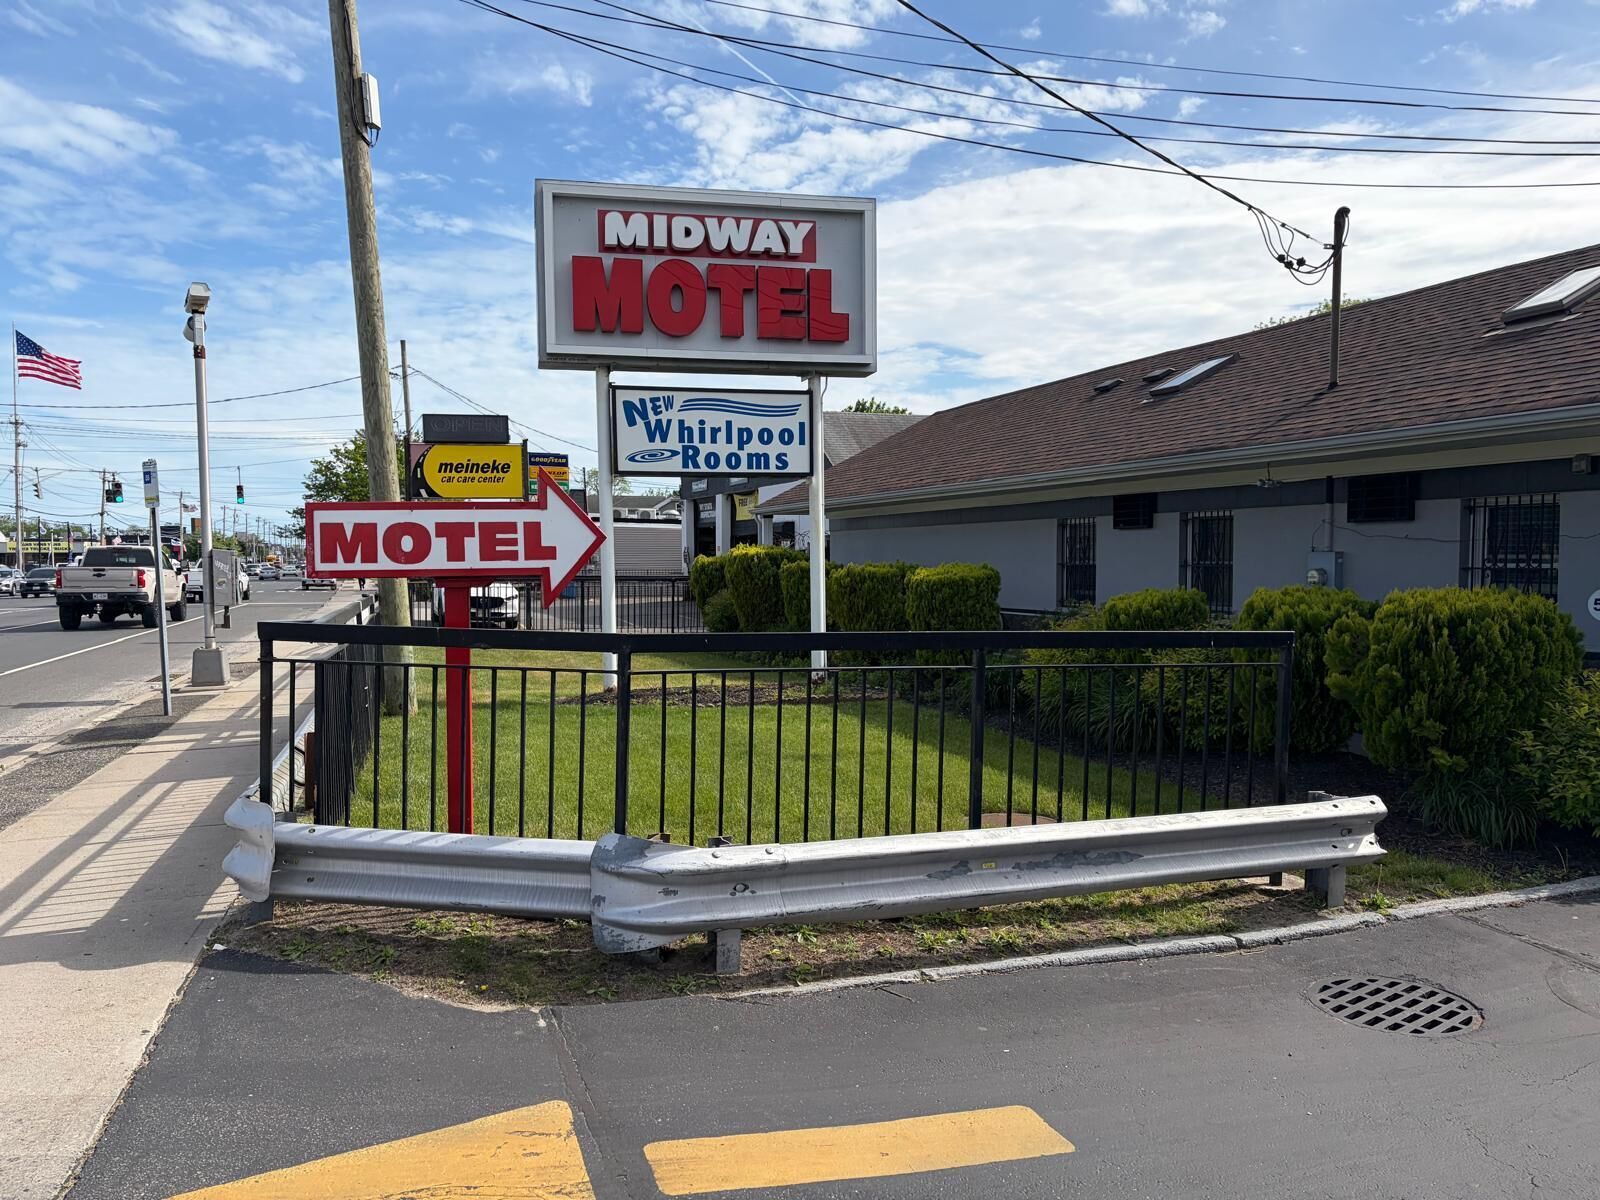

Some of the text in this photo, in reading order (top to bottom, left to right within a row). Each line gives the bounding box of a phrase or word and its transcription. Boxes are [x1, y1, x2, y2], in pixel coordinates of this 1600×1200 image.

[604, 211, 814, 256] MIDWAY
[572, 256, 849, 342] MOTEL
[430, 417, 504, 433] OPEN
[622, 394, 675, 427] NEW
[644, 418, 806, 451] Whirlpool
[437, 459, 511, 474] meineke
[681, 444, 789, 471] Rooms
[441, 475, 505, 484] car care center
[319, 521, 557, 565] MOTEL
